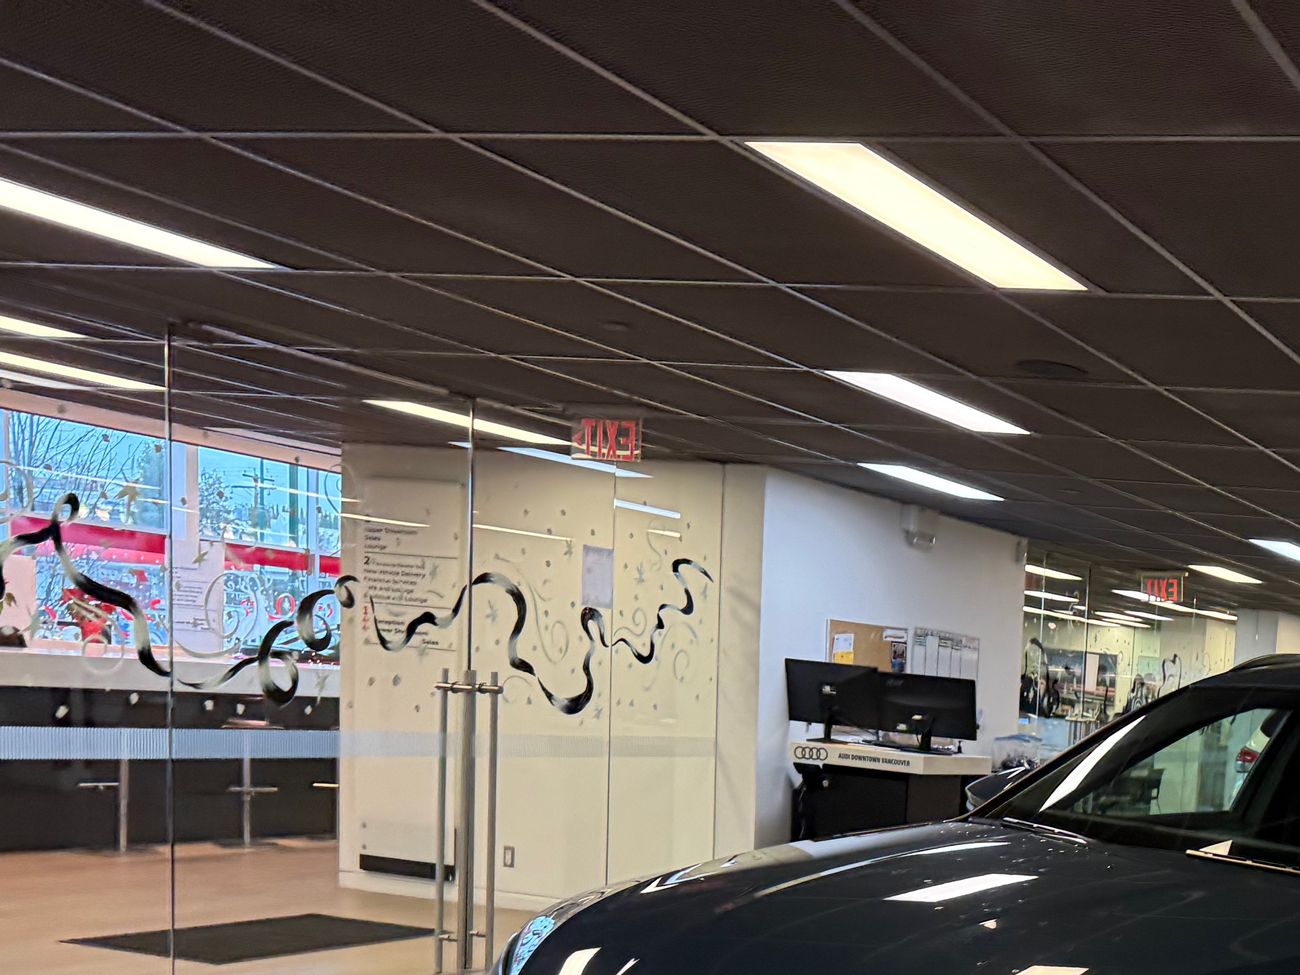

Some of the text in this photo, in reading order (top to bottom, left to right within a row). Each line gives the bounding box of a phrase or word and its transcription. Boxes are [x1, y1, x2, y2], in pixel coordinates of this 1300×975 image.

[363, 555, 371, 566] 2
[838, 752, 911, 767] AUDI DOWNTOWN VANCOUVER
